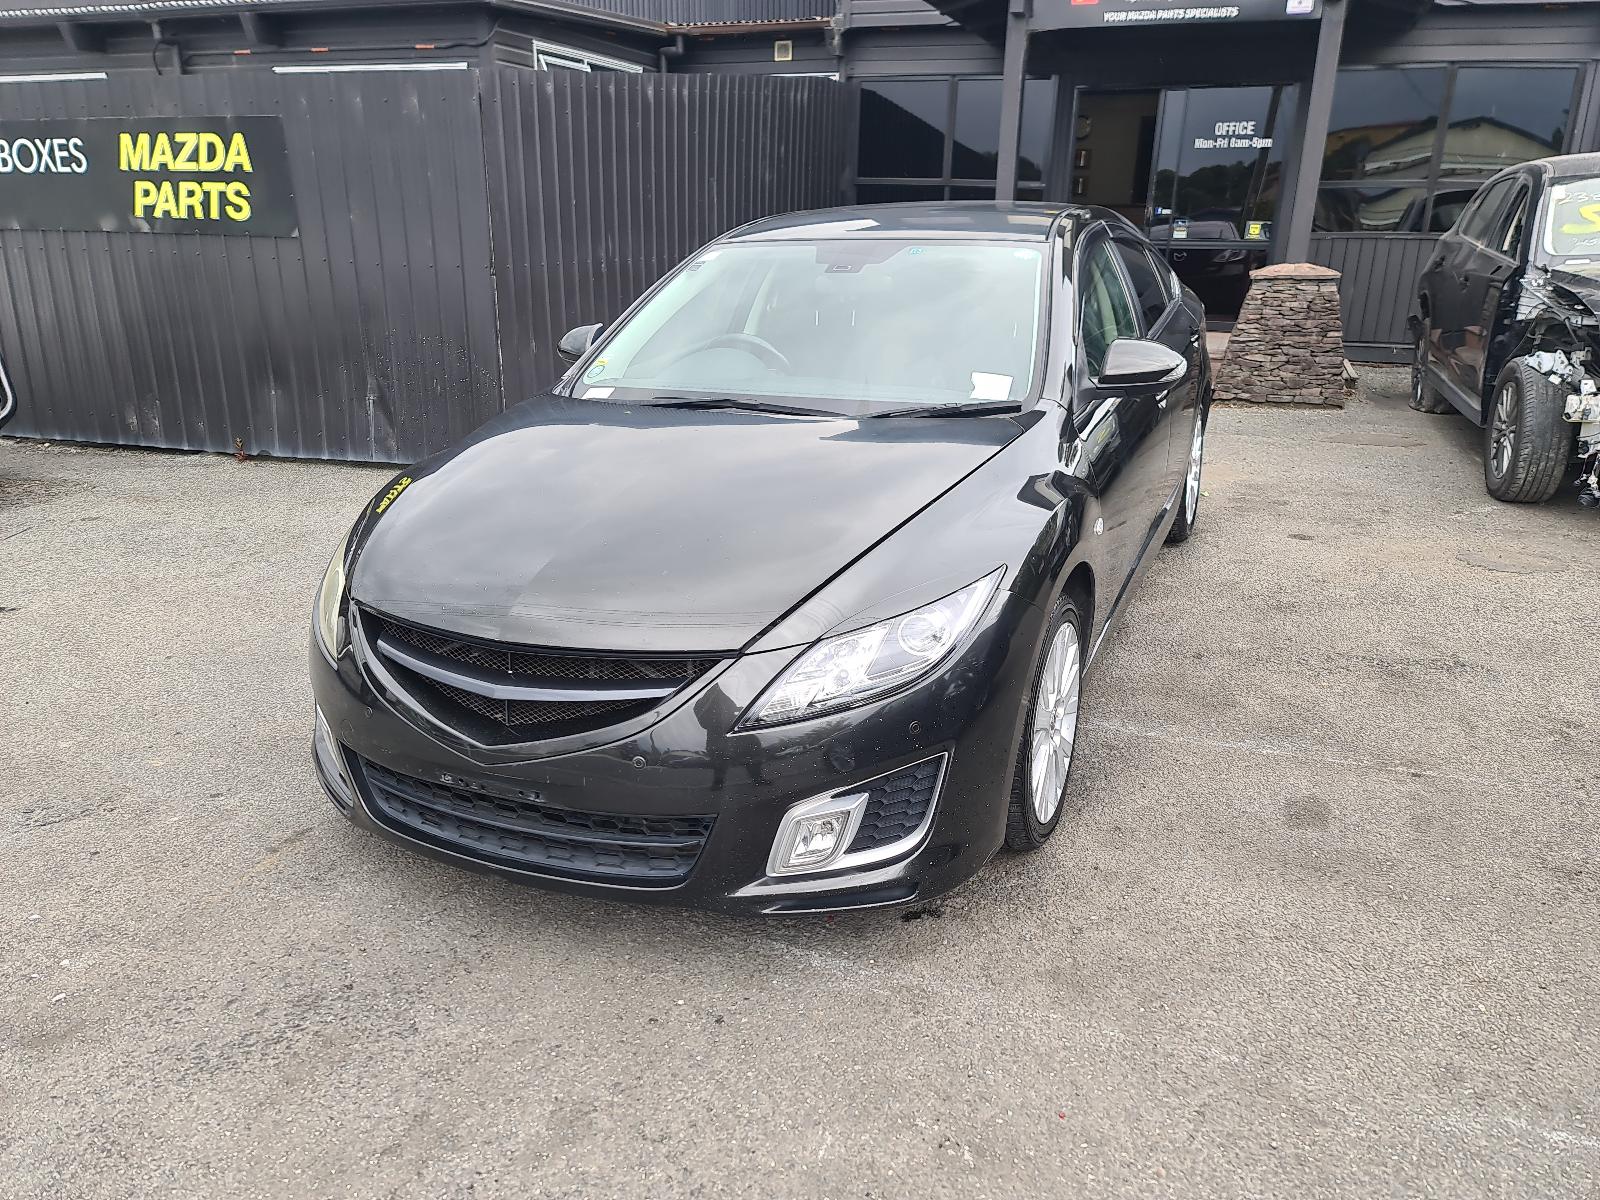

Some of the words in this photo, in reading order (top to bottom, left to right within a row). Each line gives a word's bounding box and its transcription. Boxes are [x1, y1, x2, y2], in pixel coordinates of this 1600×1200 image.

[1103, 11, 1127, 22] YOUR
[1127, 10, 1157, 21] MAZDA
[1157, 9, 1185, 20] PARTS
[1185, 6, 1240, 19] SPECIALISTS
[1214, 121, 1257, 136] OFFICE
[0, 137, 88, 174] BOXES
[118, 132, 253, 173] MAZDA
[1194, 138, 1229, 149] Mon-Fri
[133, 180, 252, 222] PARTS
